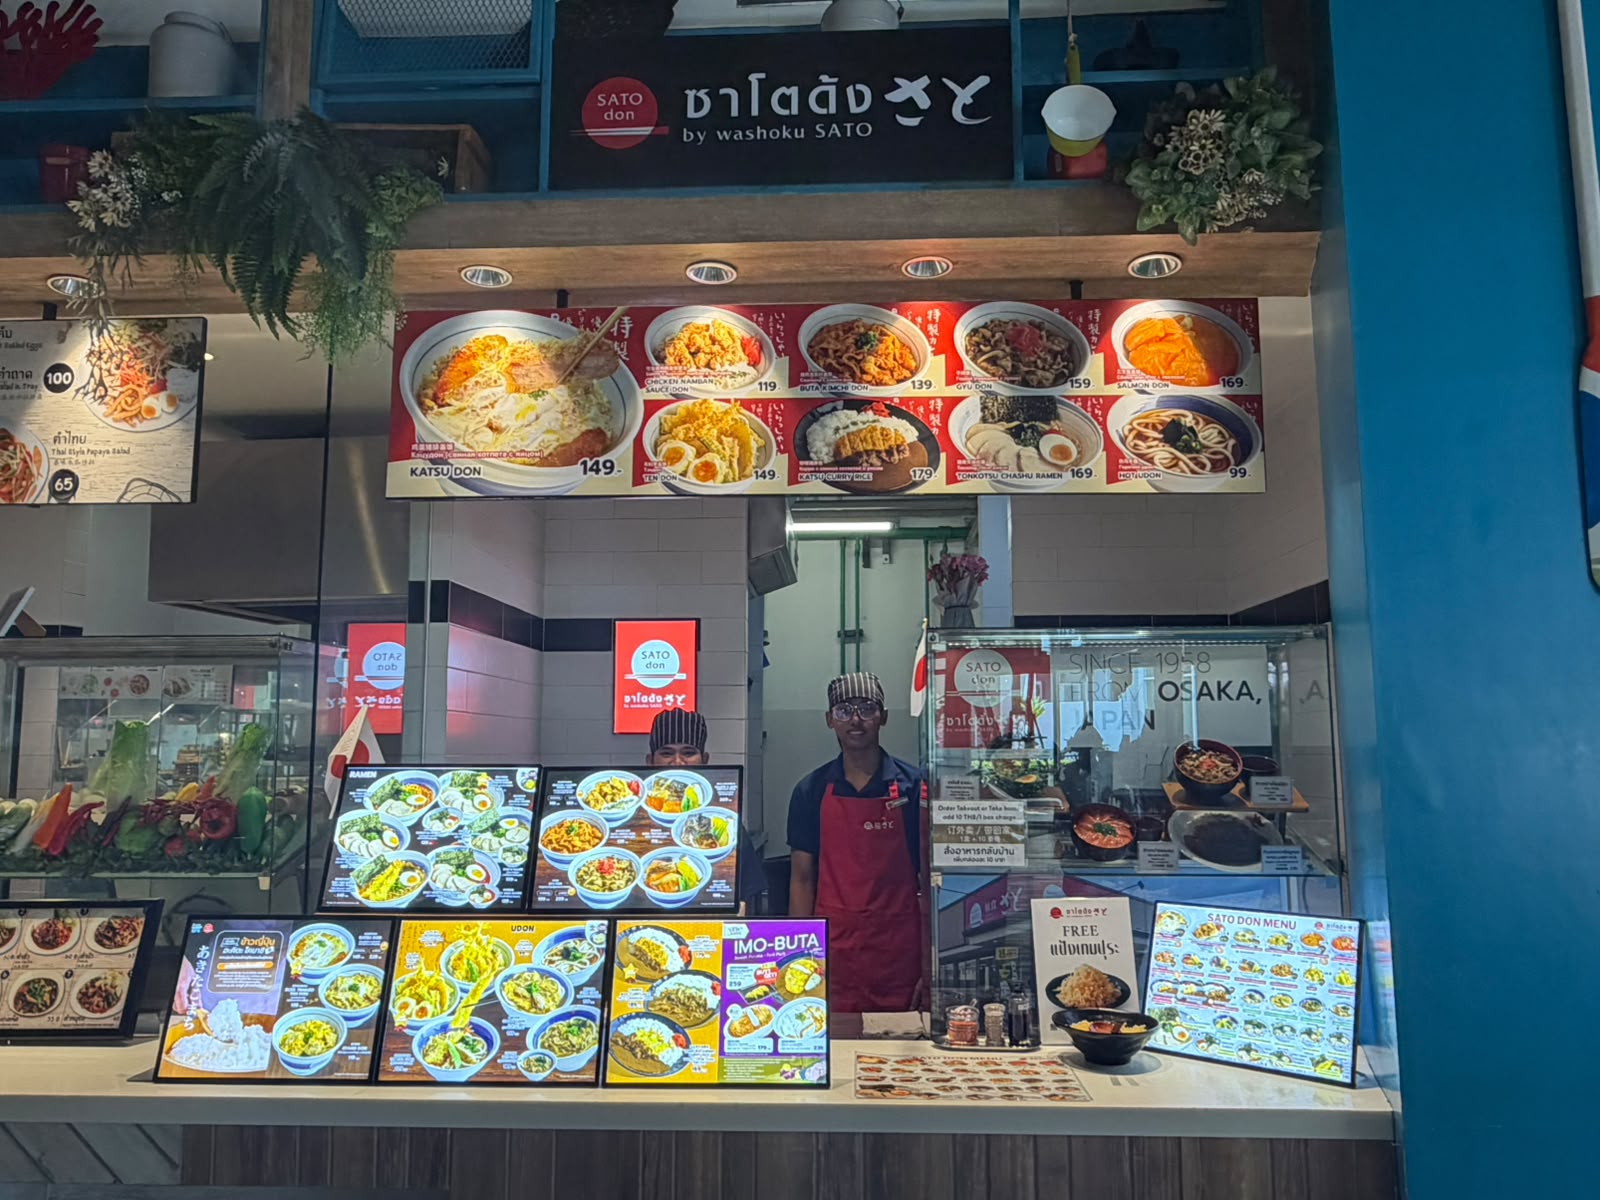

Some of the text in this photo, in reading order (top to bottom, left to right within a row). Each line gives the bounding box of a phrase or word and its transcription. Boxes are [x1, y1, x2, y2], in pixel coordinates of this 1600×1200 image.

[597, 93, 643, 108] SATO
[684, 73, 872, 119] ซาโตดัง
[604, 108, 635, 122] don
[683, 123, 872, 145] by washoku SATO
[47, 372, 72, 385] 100
[680, 378, 714, 386] NAMBAN
[646, 386, 670, 394] SAUCE
[800, 384, 869, 392] BUTA KIMCHI DON
[956, 383, 972, 391] GYU
[410, 466, 481, 478] KATSU DON
[644, 474, 678, 482] TEN DON
[800, 473, 824, 481] KATSU
[826, 473, 853, 481] CURRY
[957, 472, 999, 480] TONKOTSU
[1001, 472, 1034, 480] CHASHU
[54, 477, 73, 492] 65
[641, 651, 671, 660] SATO
[645, 661, 665, 670] don
[966, 662, 1002, 672] SATO
[1070, 651, 1211, 675] SINCE 1958
[971, 674, 996, 685] don
[1158, 680, 1262, 705] OSAKA,
[1075, 709, 1155, 731] JAPAN
[1207, 912, 1297, 931] SATO DON MENU
[1063, 925, 1100, 937] FREE
[734, 933, 819, 954] IMO-BUTA
[1050, 940, 1121, 960] แป้งเทมปุระ
